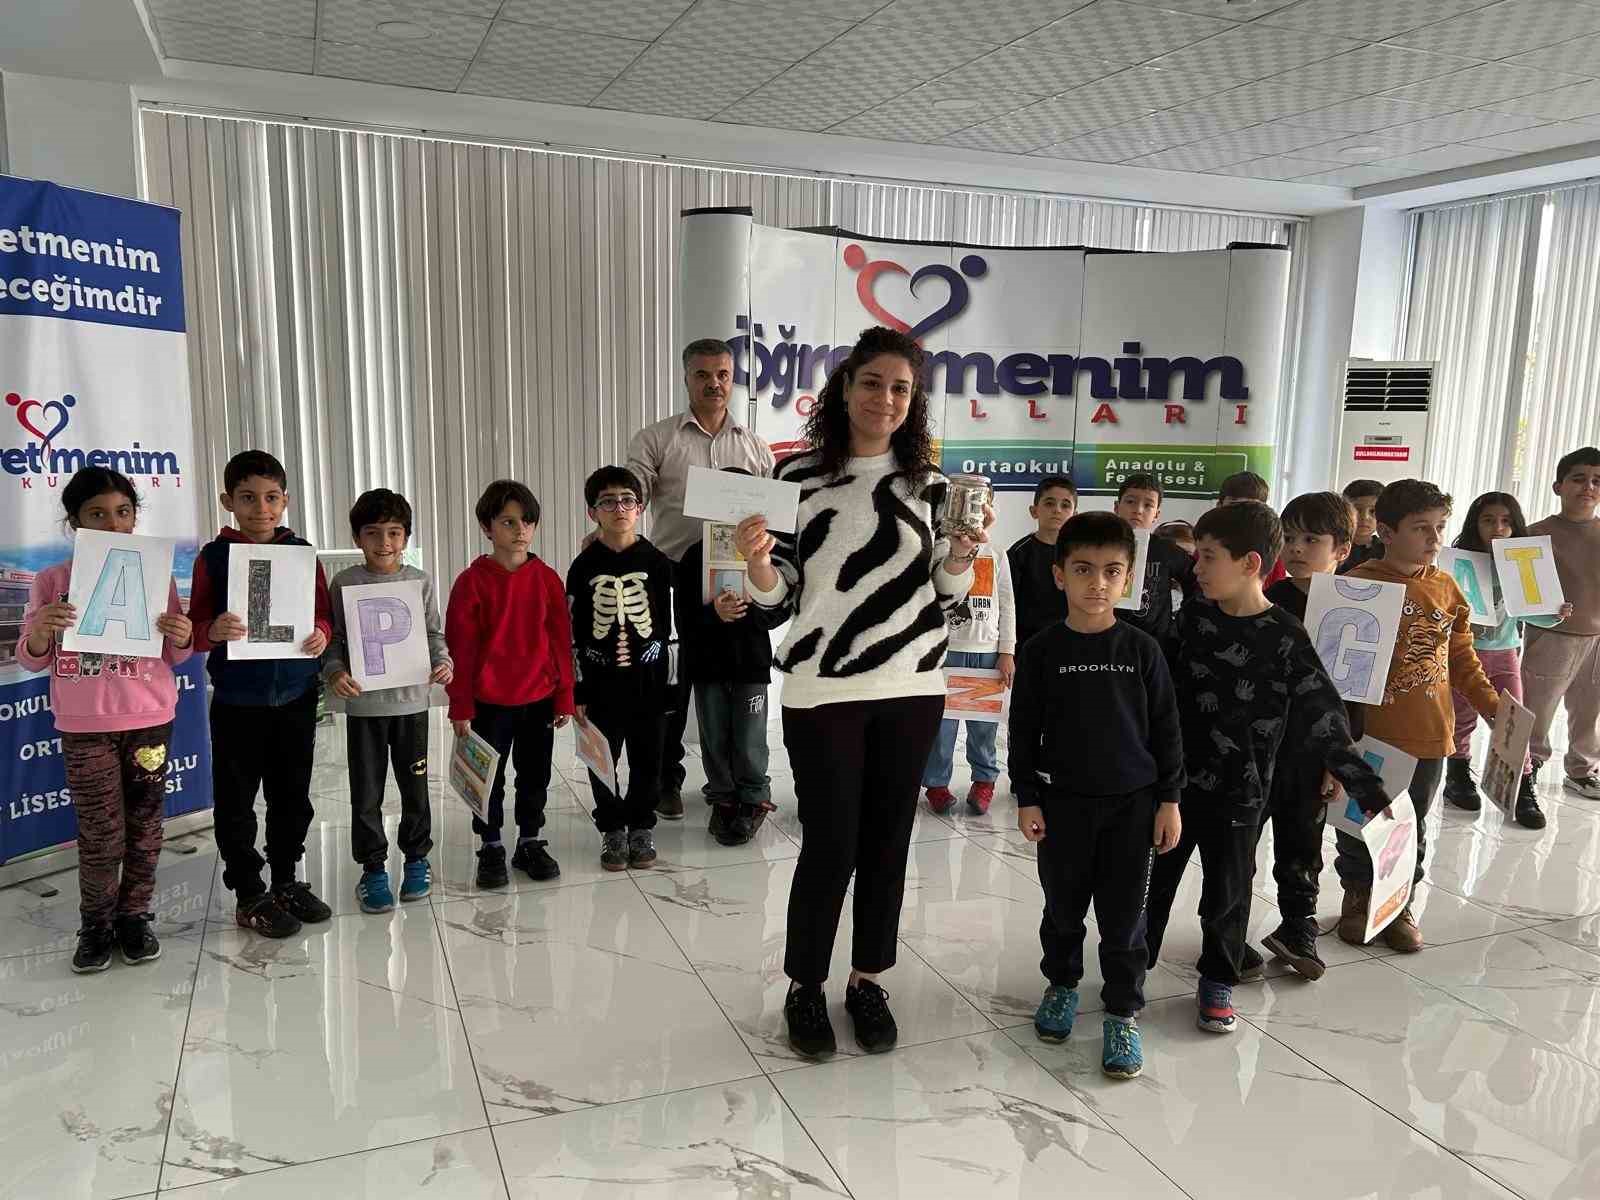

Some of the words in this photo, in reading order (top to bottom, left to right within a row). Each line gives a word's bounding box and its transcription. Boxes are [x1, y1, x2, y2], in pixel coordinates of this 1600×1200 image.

[962, 459, 1071, 474] Ortaokul
[1105, 459, 1186, 471] Anadolu
[1147, 473, 1205, 485] isesi
[1504, 547, 1543, 605] T
[76, 548, 150, 640] A
[247, 559, 294, 643] L
[357, 596, 412, 676] P
[1059, 663, 1135, 673] BROOKLYN
[9, 788, 76, 820] LİSES
